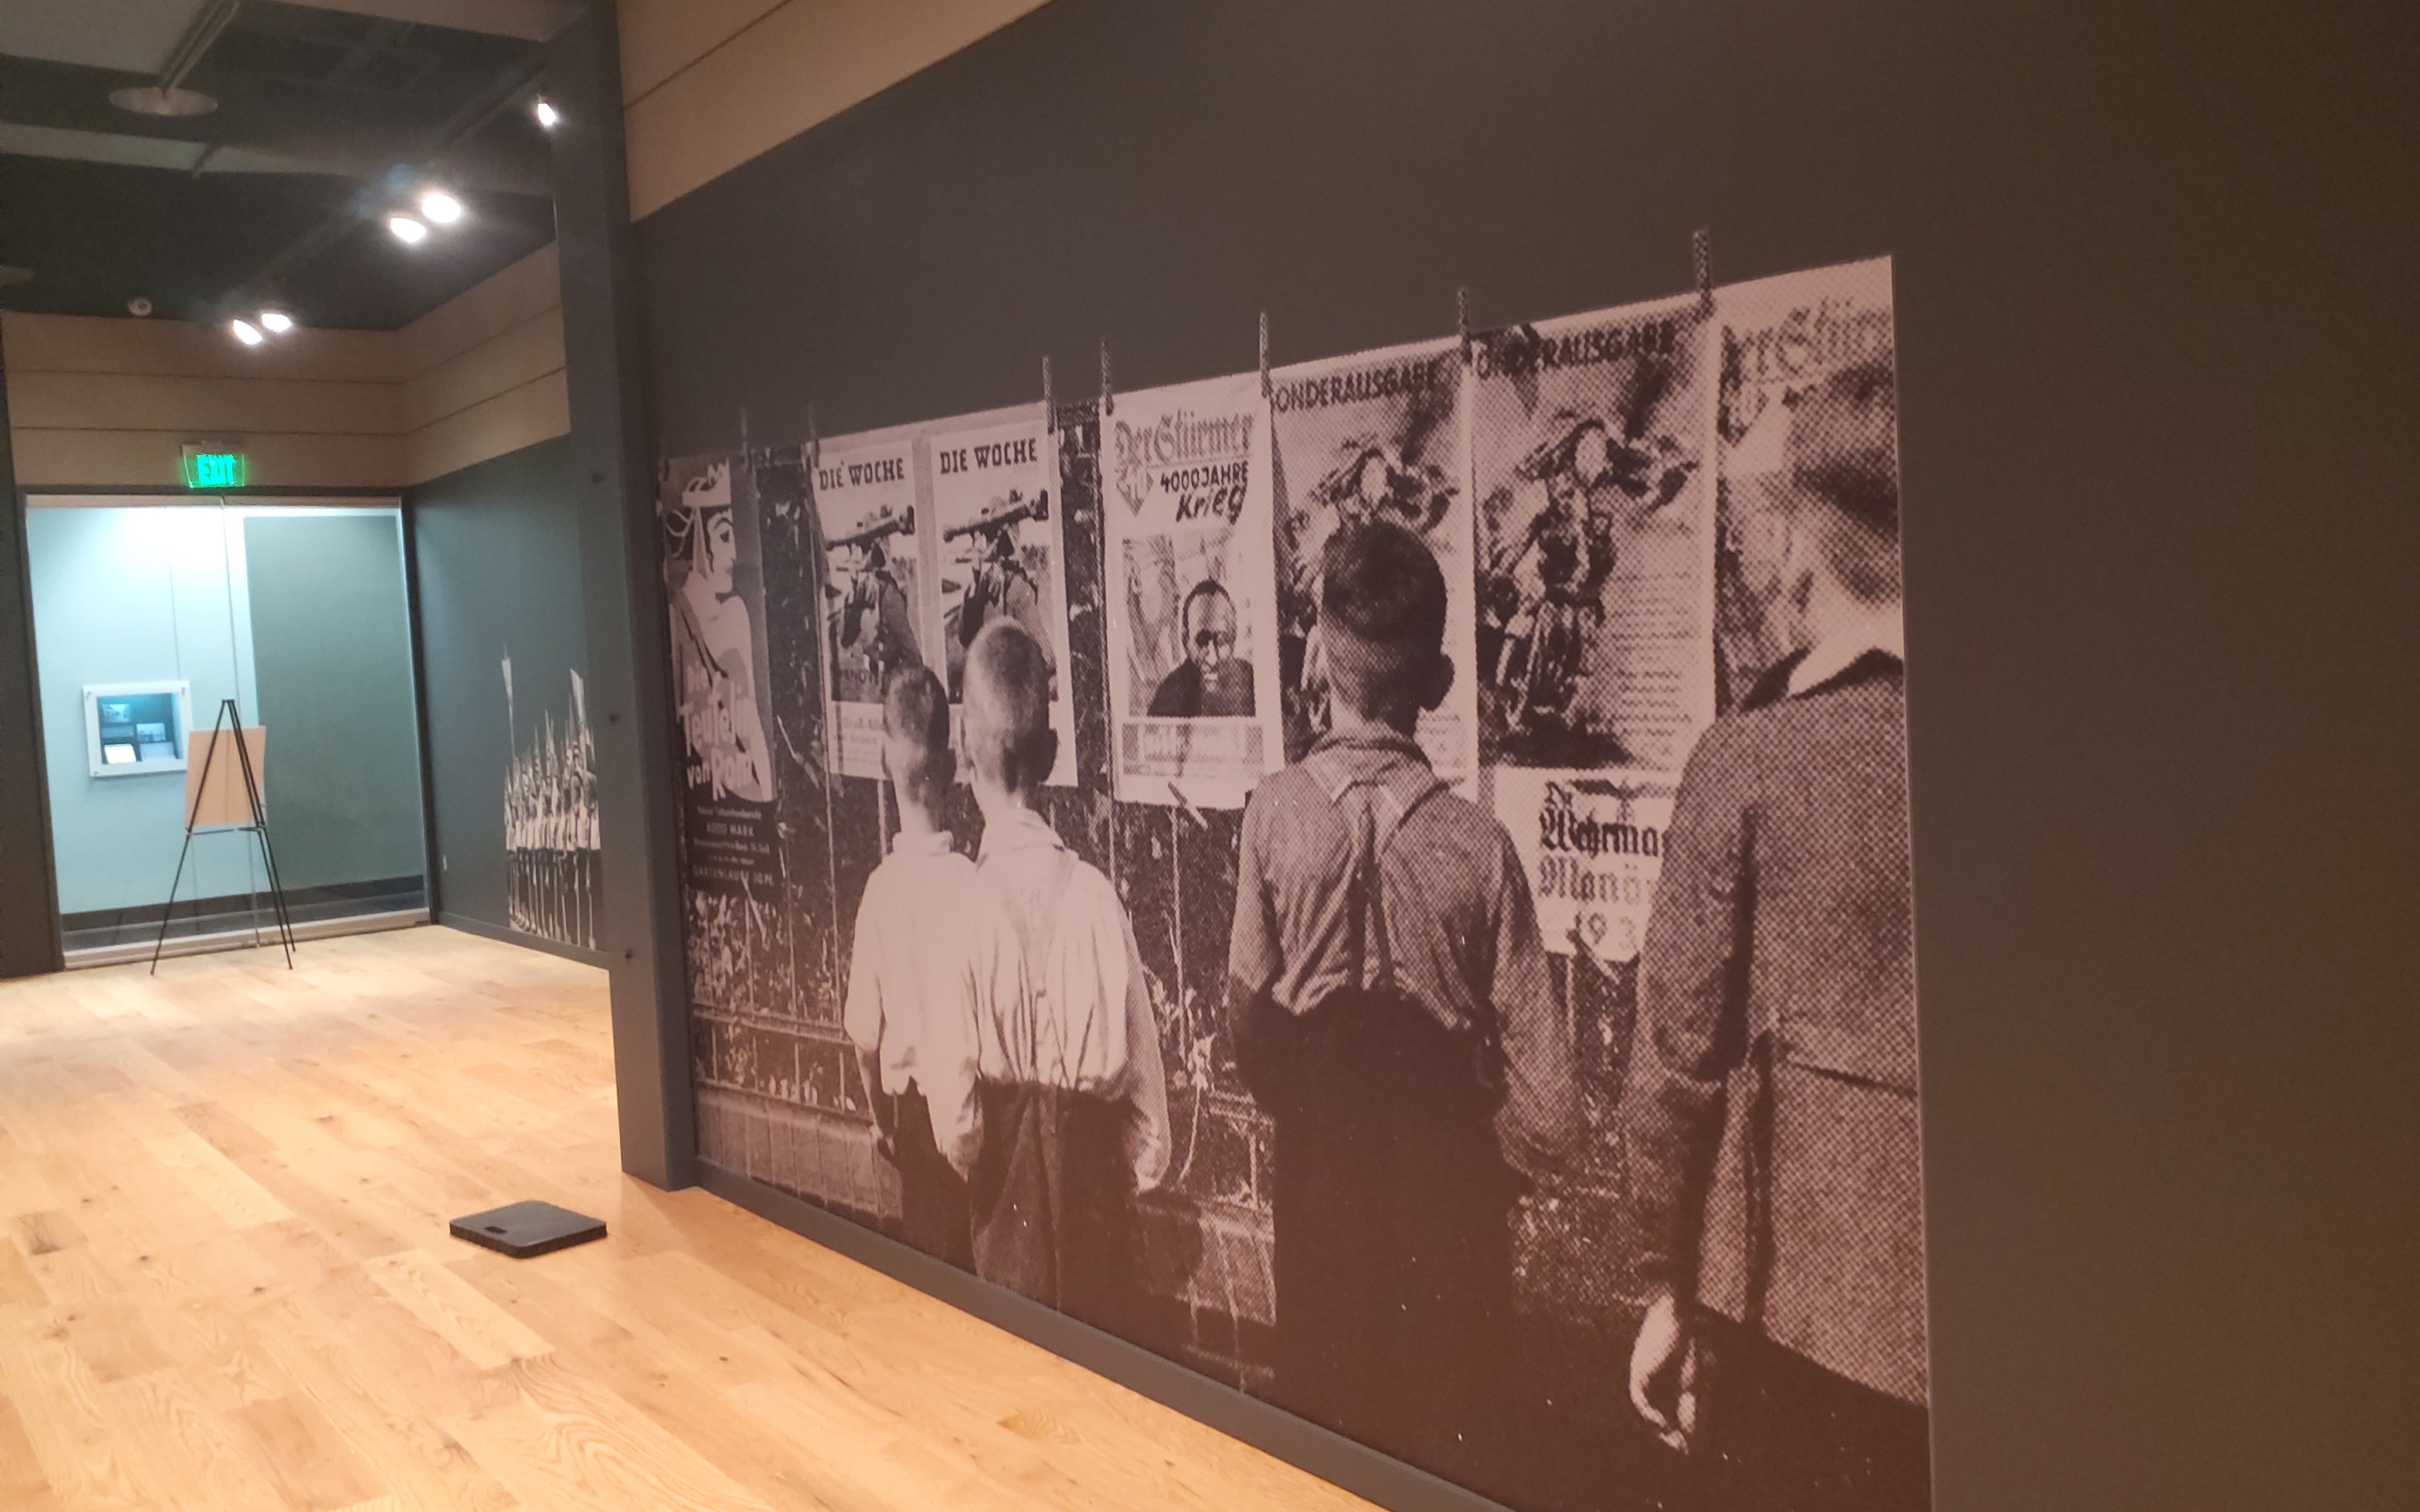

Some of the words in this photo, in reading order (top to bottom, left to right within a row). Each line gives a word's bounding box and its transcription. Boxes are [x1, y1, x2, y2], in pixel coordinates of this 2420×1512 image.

[197, 454, 235, 485] EXIT
[940, 448, 969, 475] DIE
[973, 437, 1038, 469] WOCHE
[819, 465, 845, 491] DIE
[848, 457, 905, 486] WOCHE
[686, 761, 711, 789] von
[1538, 855, 1652, 905] Manö
